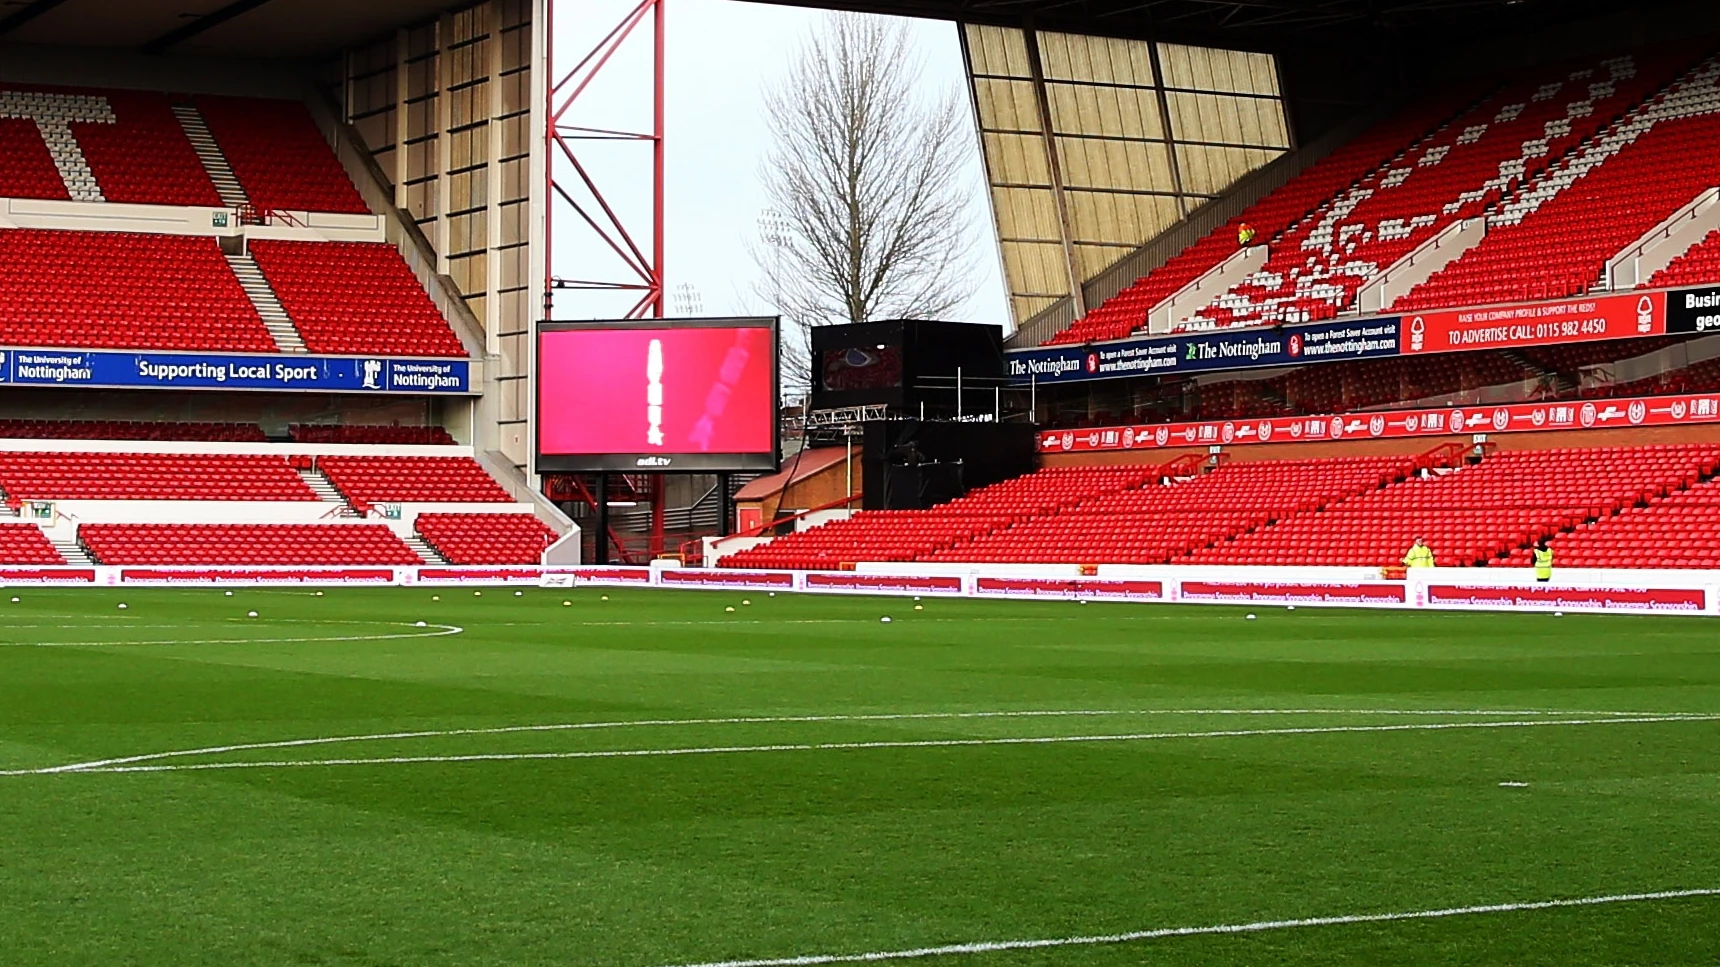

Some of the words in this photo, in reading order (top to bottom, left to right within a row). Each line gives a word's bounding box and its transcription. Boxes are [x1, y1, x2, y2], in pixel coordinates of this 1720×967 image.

[1474, 312, 1487, 321] YOUR
[1488, 310, 1515, 320] COMPANY
[1515, 307, 1536, 318] PROFILE
[1542, 305, 1566, 316] SUPPORT
[1567, 304, 1577, 313] THE
[1449, 330, 1460, 344] TO
[1461, 326, 1508, 344] ADVERTISE
[1509, 325, 1535, 339] CALL:
[1536, 322, 1559, 338] 0115
[1561, 320, 1578, 336] 982
[1581, 318, 1606, 333] 4450
[1198, 342, 1217, 359] The
[1219, 338, 1281, 363] Nottingham
[1303, 338, 1396, 356] www.thenottingham.com
[19, 355, 32, 364] The
[34, 355, 72, 365] University
[73, 356, 81, 365] of
[1010, 360, 1026, 375] The
[1028, 356, 1080, 378] Nottingham
[19, 365, 91, 382] Nottingham
[139, 361, 226, 381] Supporting
[229, 363, 270, 379] Local
[275, 364, 317, 382] Sport
[393, 364, 405, 372] The
[407, 365, 442, 374] University
[442, 365, 451, 373] of
[393, 373, 460, 389] Nottingham
